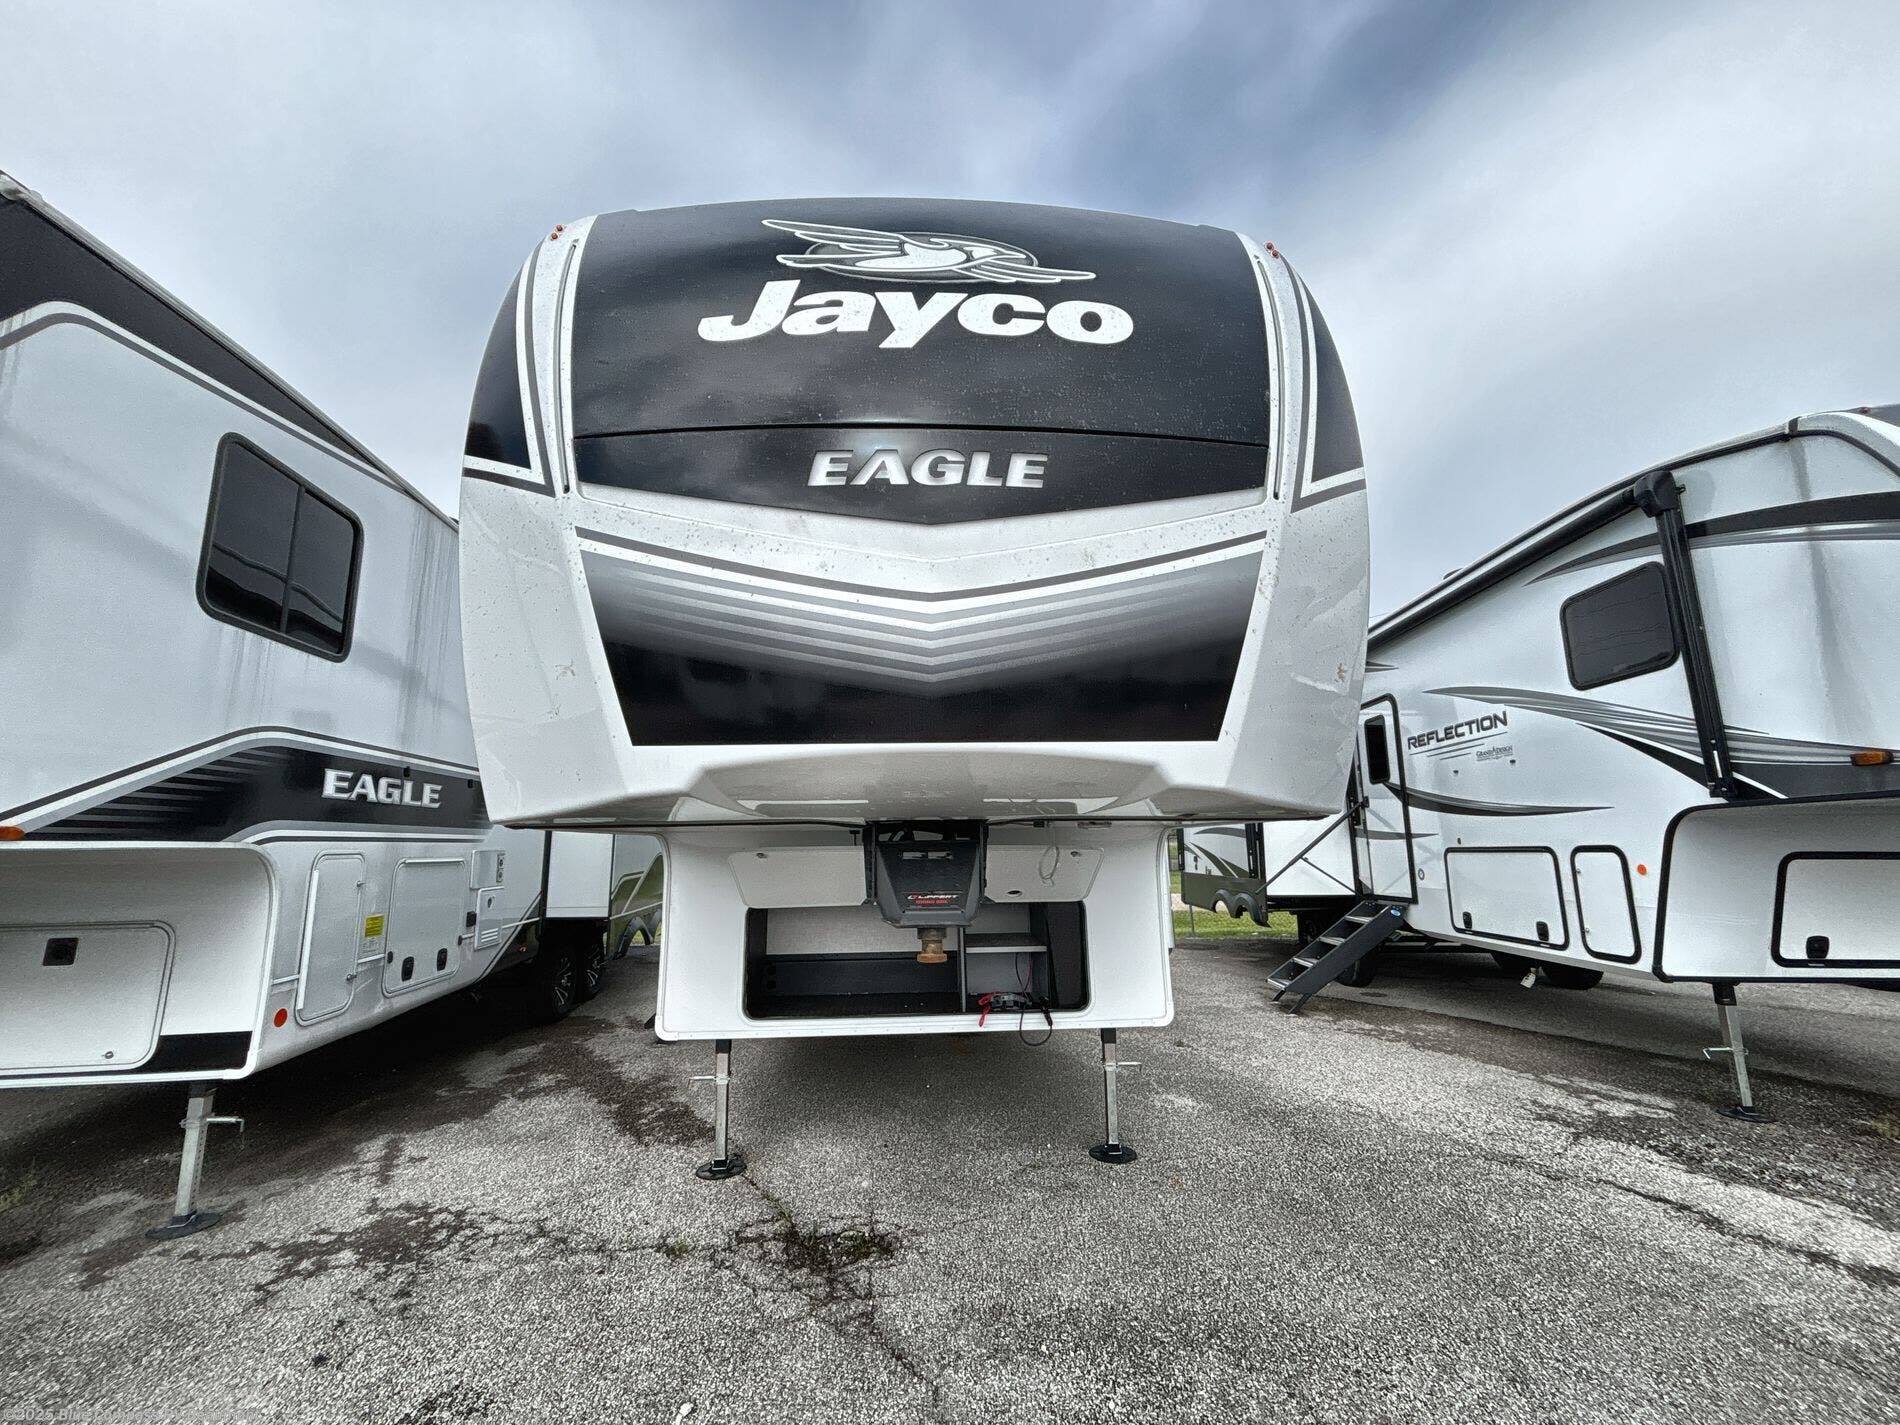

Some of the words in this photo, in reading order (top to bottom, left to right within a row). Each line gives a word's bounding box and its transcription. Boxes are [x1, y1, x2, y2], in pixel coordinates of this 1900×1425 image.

[698, 279, 1134, 348] Jayco
[807, 449, 1049, 489] EAGLE
[1407, 710, 1508, 750] REFLECTION
[321, 768, 442, 809] EAGLE
